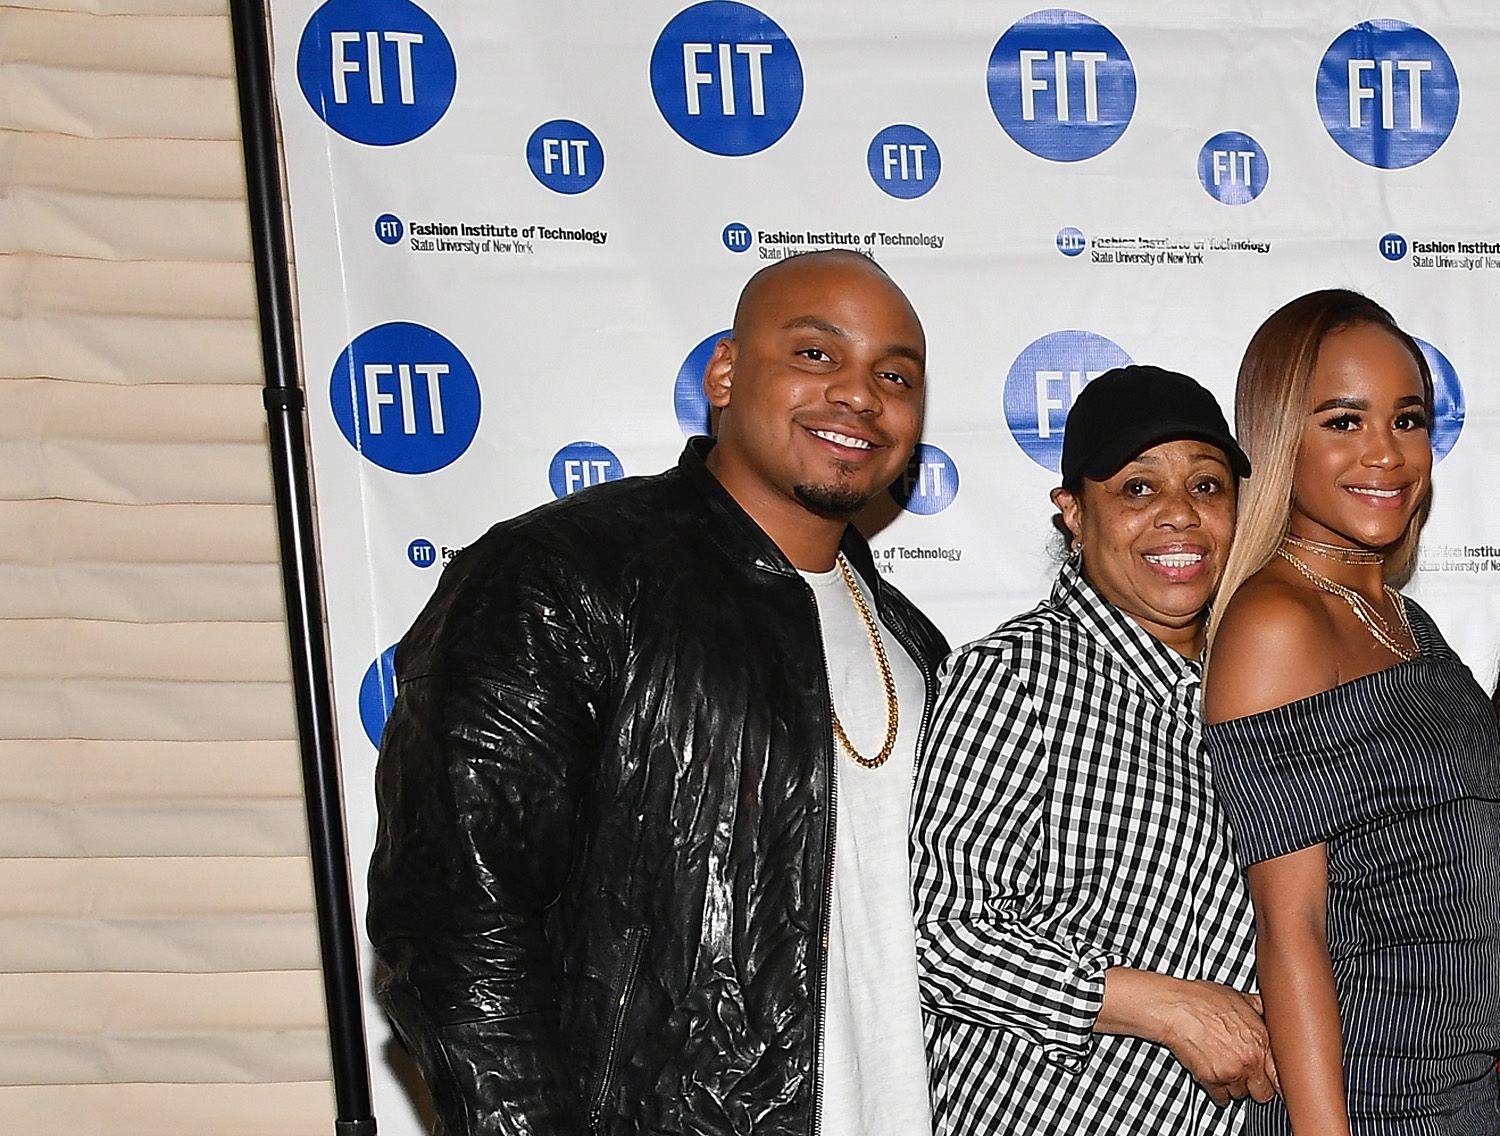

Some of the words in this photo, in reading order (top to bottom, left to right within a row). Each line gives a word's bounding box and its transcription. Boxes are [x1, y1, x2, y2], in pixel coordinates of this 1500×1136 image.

[331, 32, 423, 105] FIT
[683, 43, 773, 116] FIT
[1019, 50, 1107, 122] FIT
[1347, 59, 1432, 130] FIT
[543, 139, 590, 176] FIT
[883, 144, 927, 180] FIT
[1212, 150, 1256, 186] FIT
[381, 222, 398, 237] FIT
[410, 222, 458, 236] Fashion
[461, 224, 518, 238] Institute
[522, 226, 536, 238] of
[538, 226, 608, 244] Technology
[729, 231, 747, 246] FIT
[411, 239, 434, 251] State
[437, 239, 480, 255] University
[482, 240, 492, 251] of
[493, 241, 512, 253] New
[512, 242, 533, 254] York
[758, 231, 804, 244] Fashion
[807, 232, 860, 244] Institute
[864, 232, 876, 245] of
[878, 233, 944, 248] Technology
[1385, 241, 1402, 254] FIT
[1413, 241, 1455, 253] Fashion
[1091, 251, 1113, 263] State
[1115, 252, 1156, 265] University
[1156, 252, 1166, 263] of
[1168, 252, 1184, 264] New
[1185, 252, 1204, 264] York
[1412, 256, 1434, 268] State
[1435, 256, 1474, 270] University
[1475, 256, 1484, 268] of
[1485, 257, 1500, 268] New
[364, 364, 450, 435] FIT
[903, 462, 946, 498] FIT
[414, 546, 431, 561] FIT
[883, 547, 896, 559] of
[897, 547, 962, 561] Technology
